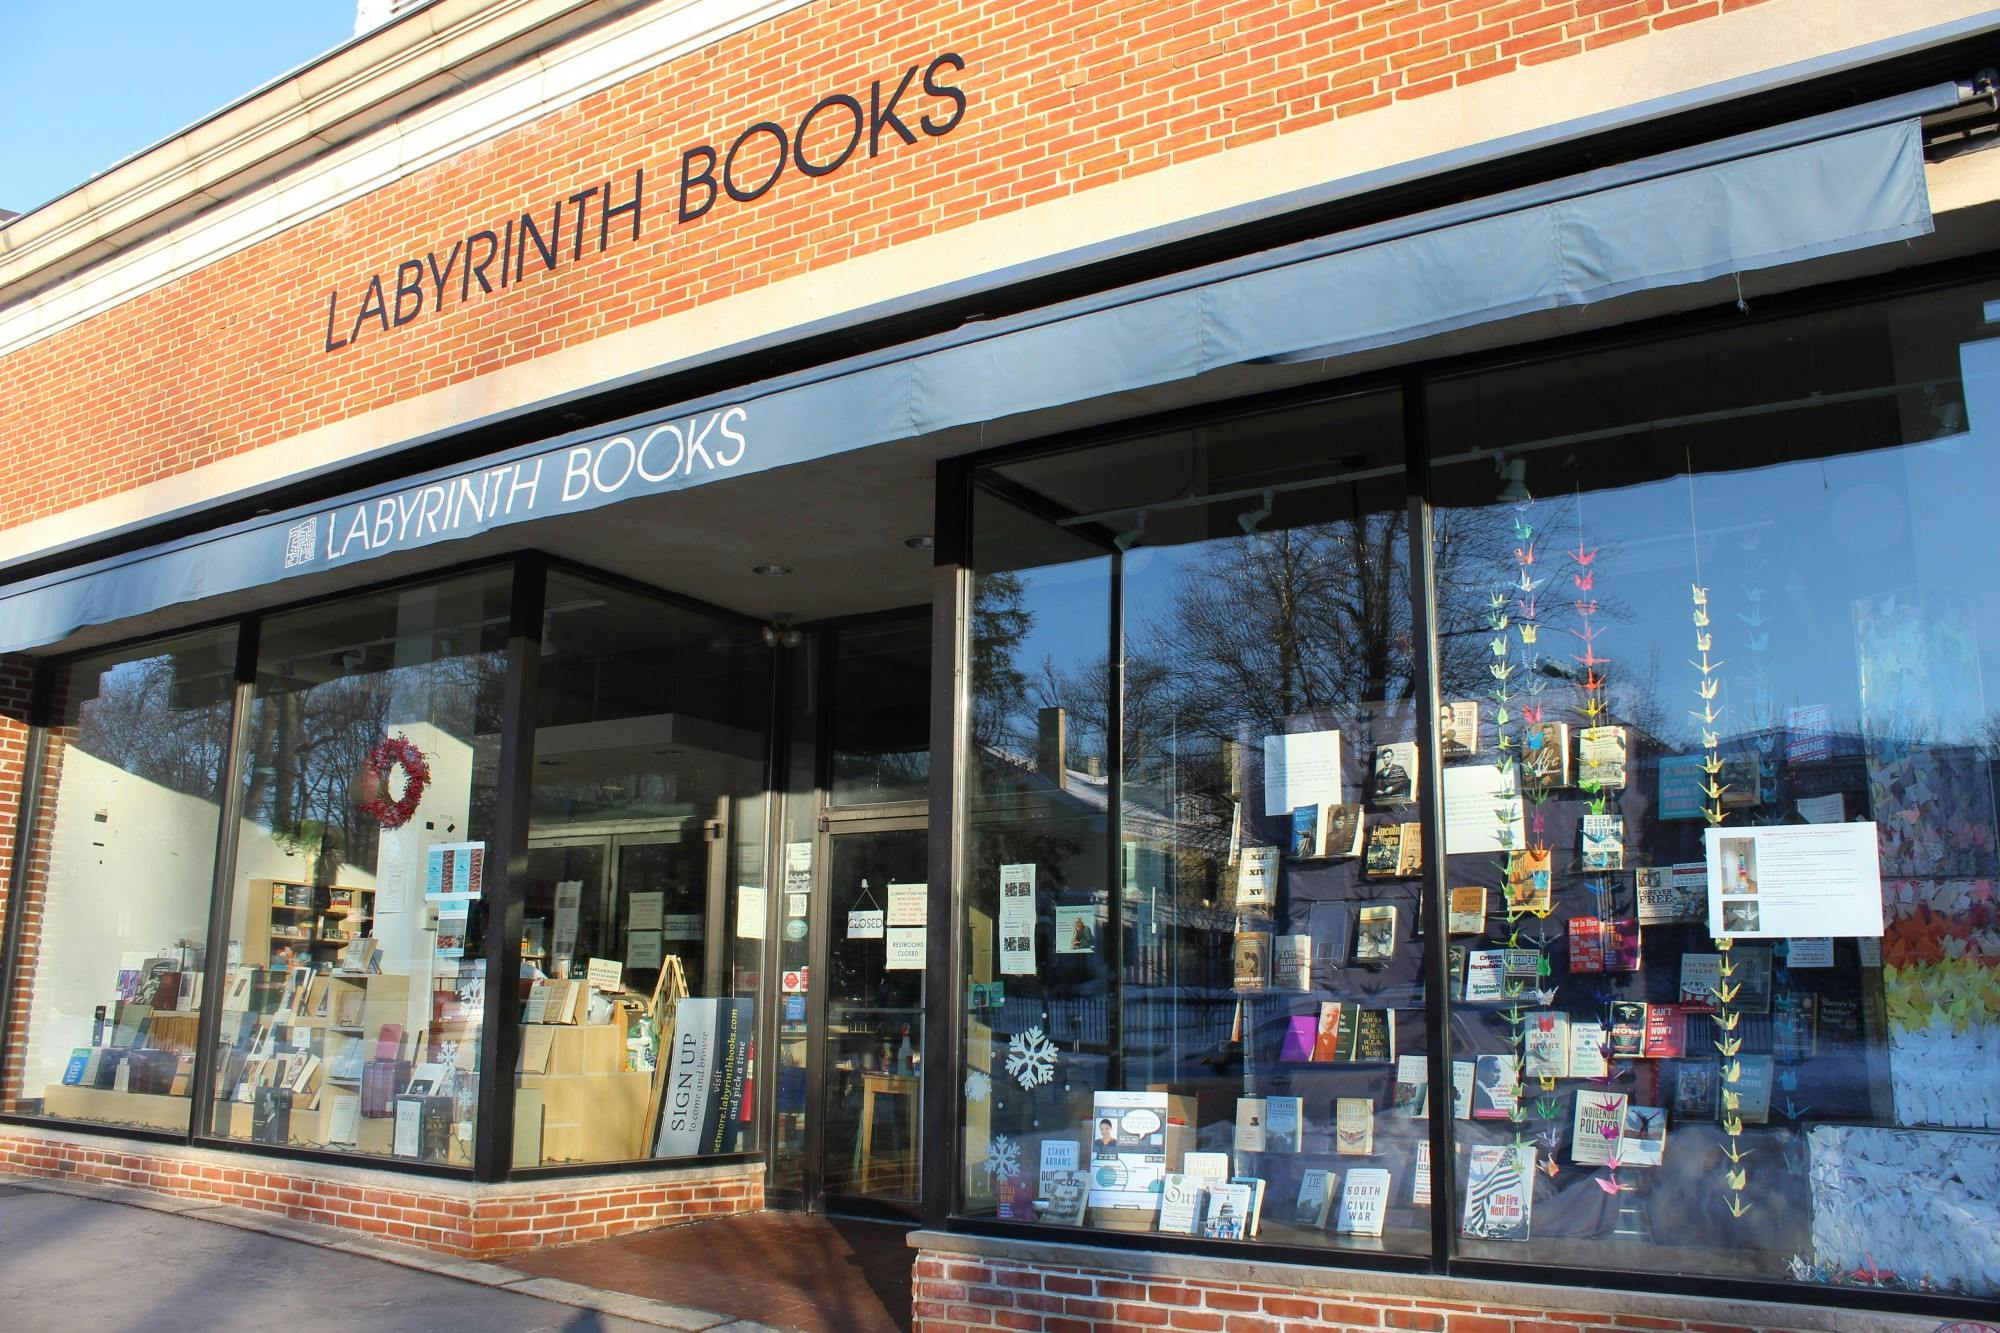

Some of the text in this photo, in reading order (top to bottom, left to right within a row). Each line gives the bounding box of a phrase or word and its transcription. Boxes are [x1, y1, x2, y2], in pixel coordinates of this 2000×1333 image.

[324, 52, 967, 354] LABYRINTH BOOKS
[326, 406, 748, 561] LABYRINTH BOOKS
[1249, 868, 1266, 876] XIV
[1249, 888, 1262, 896] XV
[1639, 888, 1672, 896] FOREVER
[1640, 895, 1673, 904] FREE
[848, 918, 882, 928] CLOSED
[1822, 999, 1848, 1009] Slavery
[1652, 1008, 1672, 1016] CAN'T
[1822, 1008, 1852, 1016] Another
[1822, 1016, 1841, 1024] Name
[1650, 1026, 1672, 1035] WON'T
[737, 1041, 746, 1065] time
[672, 1033, 697, 1131] SIGN UP
[688, 1032, 709, 1132] to come and browse
[712, 1070, 723, 1093] visit
[714, 1008, 738, 1152] setmore.labyrinthbooks.com
[733, 1074, 742, 1098] pick
[730, 1101, 739, 1120] and
[1582, 1106, 1619, 1120] INDIGENOUS
[1042, 1170, 1055, 1180] OUR
[1061, 1179, 1080, 1187] CUZ
[1308, 1177, 1320, 1188] LIE
[1346, 1186, 1380, 1196] SOUTH
[1495, 1194, 1518, 1205] The Fire
[1348, 1201, 1375, 1210] CIVIL
[1490, 1206, 1520, 1216] Next Time
[1349, 1212, 1371, 1222] WAR
